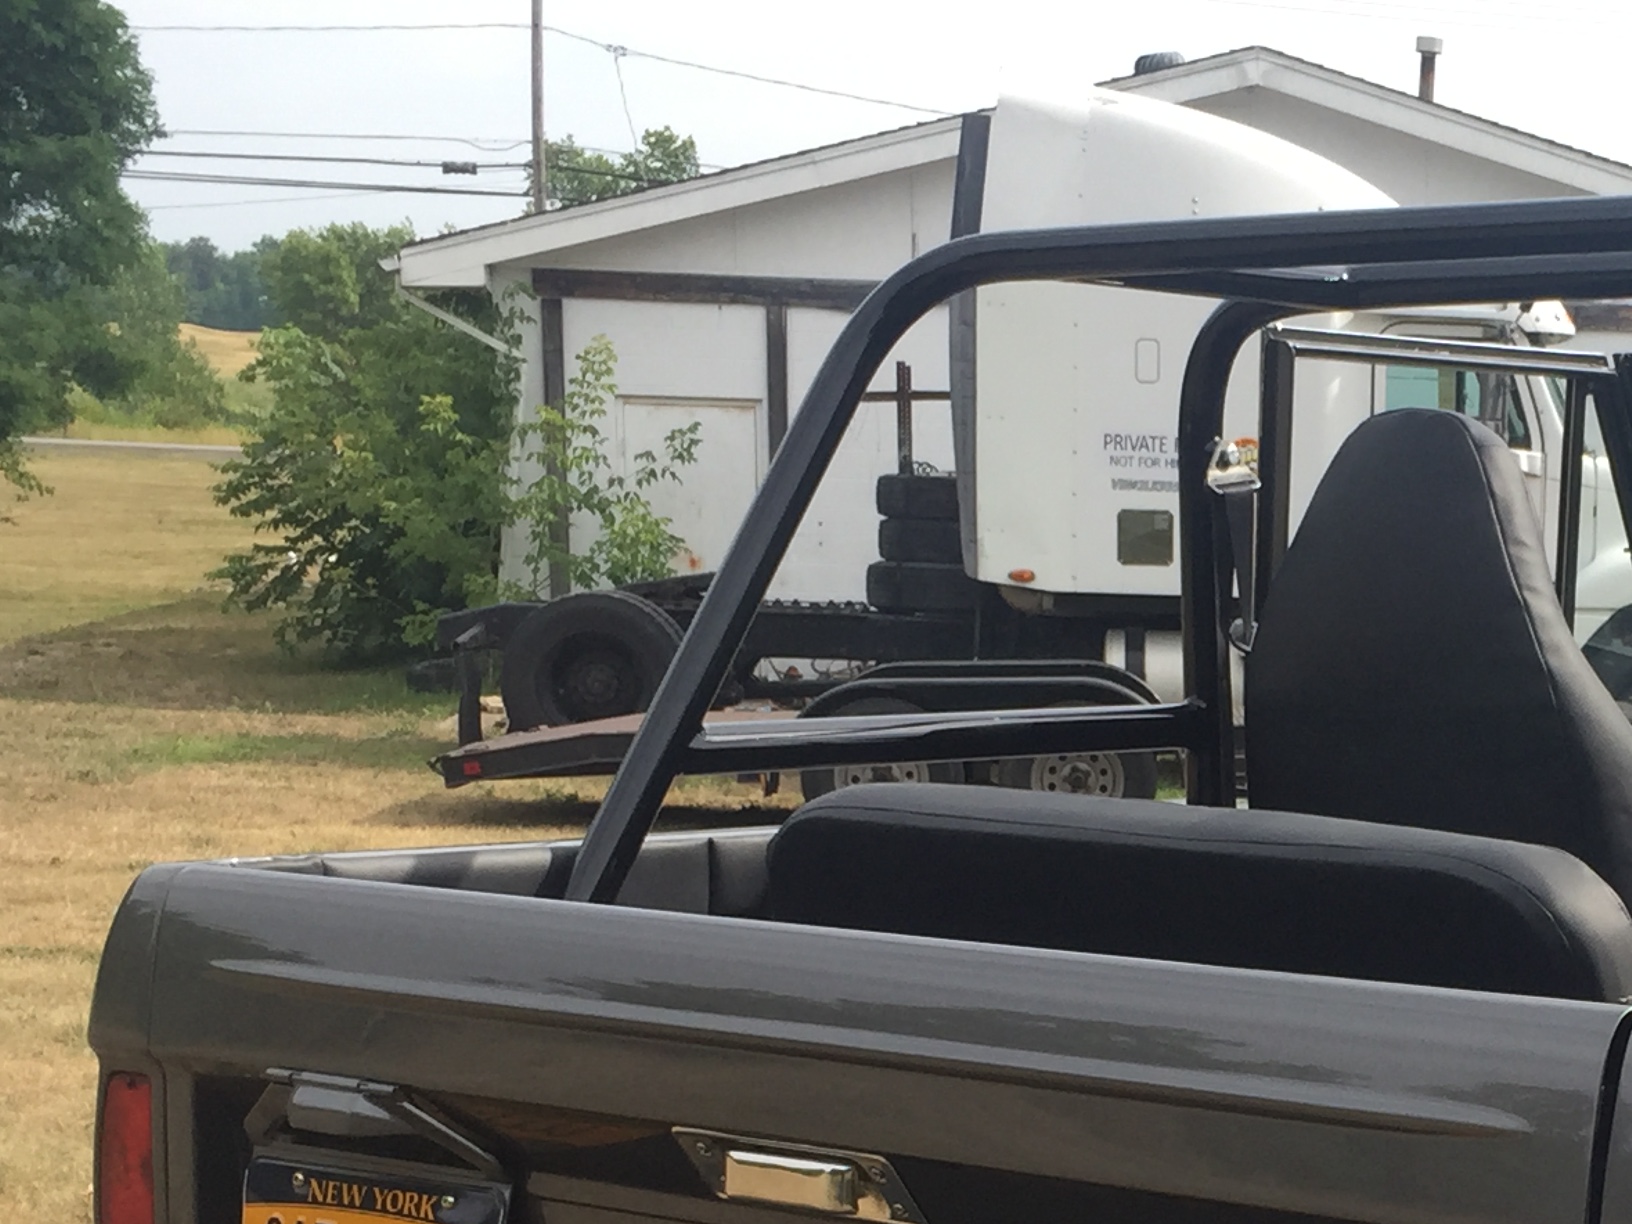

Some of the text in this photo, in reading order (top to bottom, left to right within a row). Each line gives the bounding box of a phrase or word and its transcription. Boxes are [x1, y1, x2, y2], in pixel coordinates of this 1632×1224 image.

[1103, 433, 1168, 454] PRIVATE
[1109, 455, 1134, 468] NOT
[1137, 456, 1162, 469] FOR
[308, 1178, 439, 1222] NEW YORK
